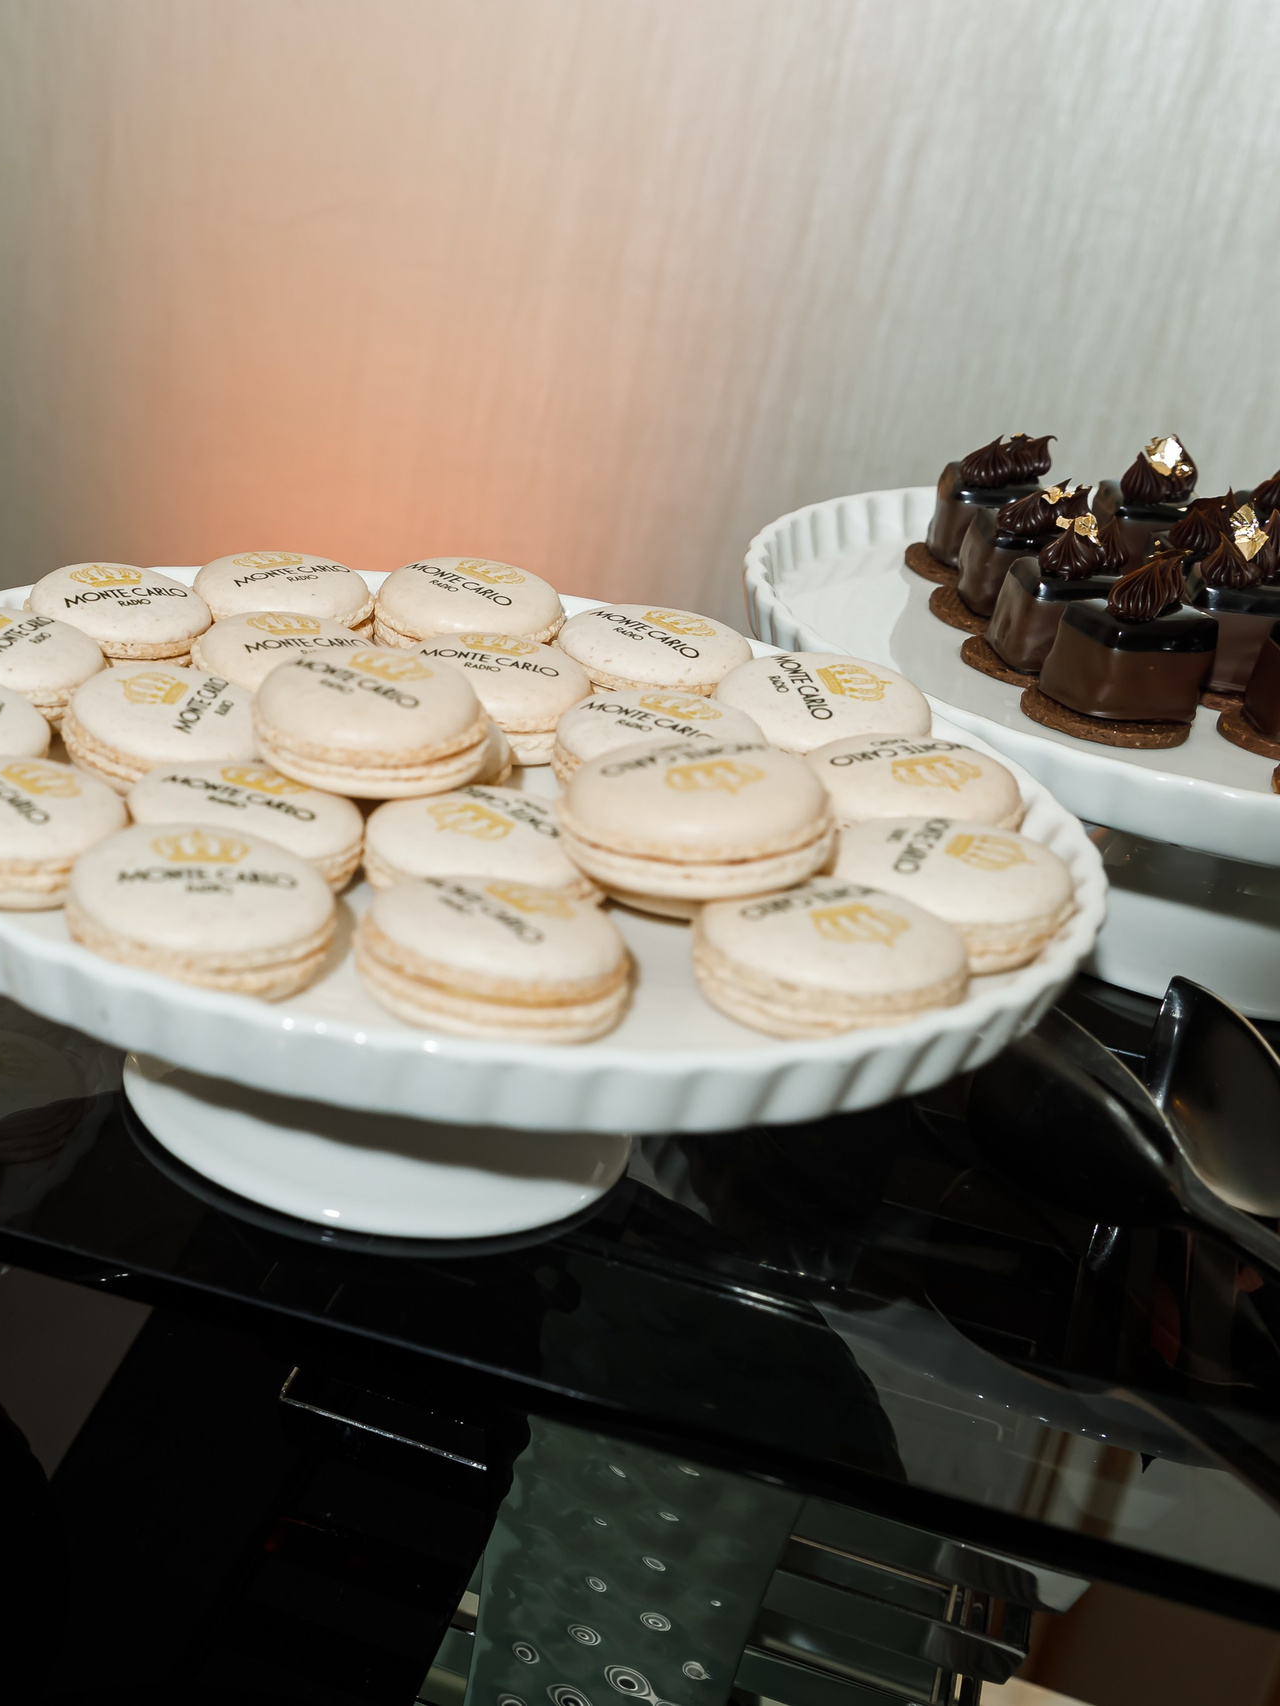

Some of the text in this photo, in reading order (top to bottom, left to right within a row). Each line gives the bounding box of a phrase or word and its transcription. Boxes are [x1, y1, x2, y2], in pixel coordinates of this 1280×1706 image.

[233, 564, 351, 588] MONTE CARLO
[286, 574, 319, 584] RADIO
[405, 562, 513, 607] MONTE CARLO
[429, 579, 459, 593] RADIO
[64, 586, 188, 609] MONTE CARLO
[117, 598, 152, 608] RADIO
[19, 616, 55, 636] CARLO
[589, 610, 700, 659] MONTE CARLO
[613, 626, 644, 641] RADIO
[244, 638, 311, 653] MONTE
[420, 648, 560, 678] MONTE CARLO
[463, 662, 502, 673] RADIO
[768, 675, 789, 694] RADIO
[771, 655, 833, 720] MONTE CARLO
[172, 677, 230, 735] MONTE CARLO
[580, 701, 653, 721] MONTE
[615, 719, 652, 733] RADIO
